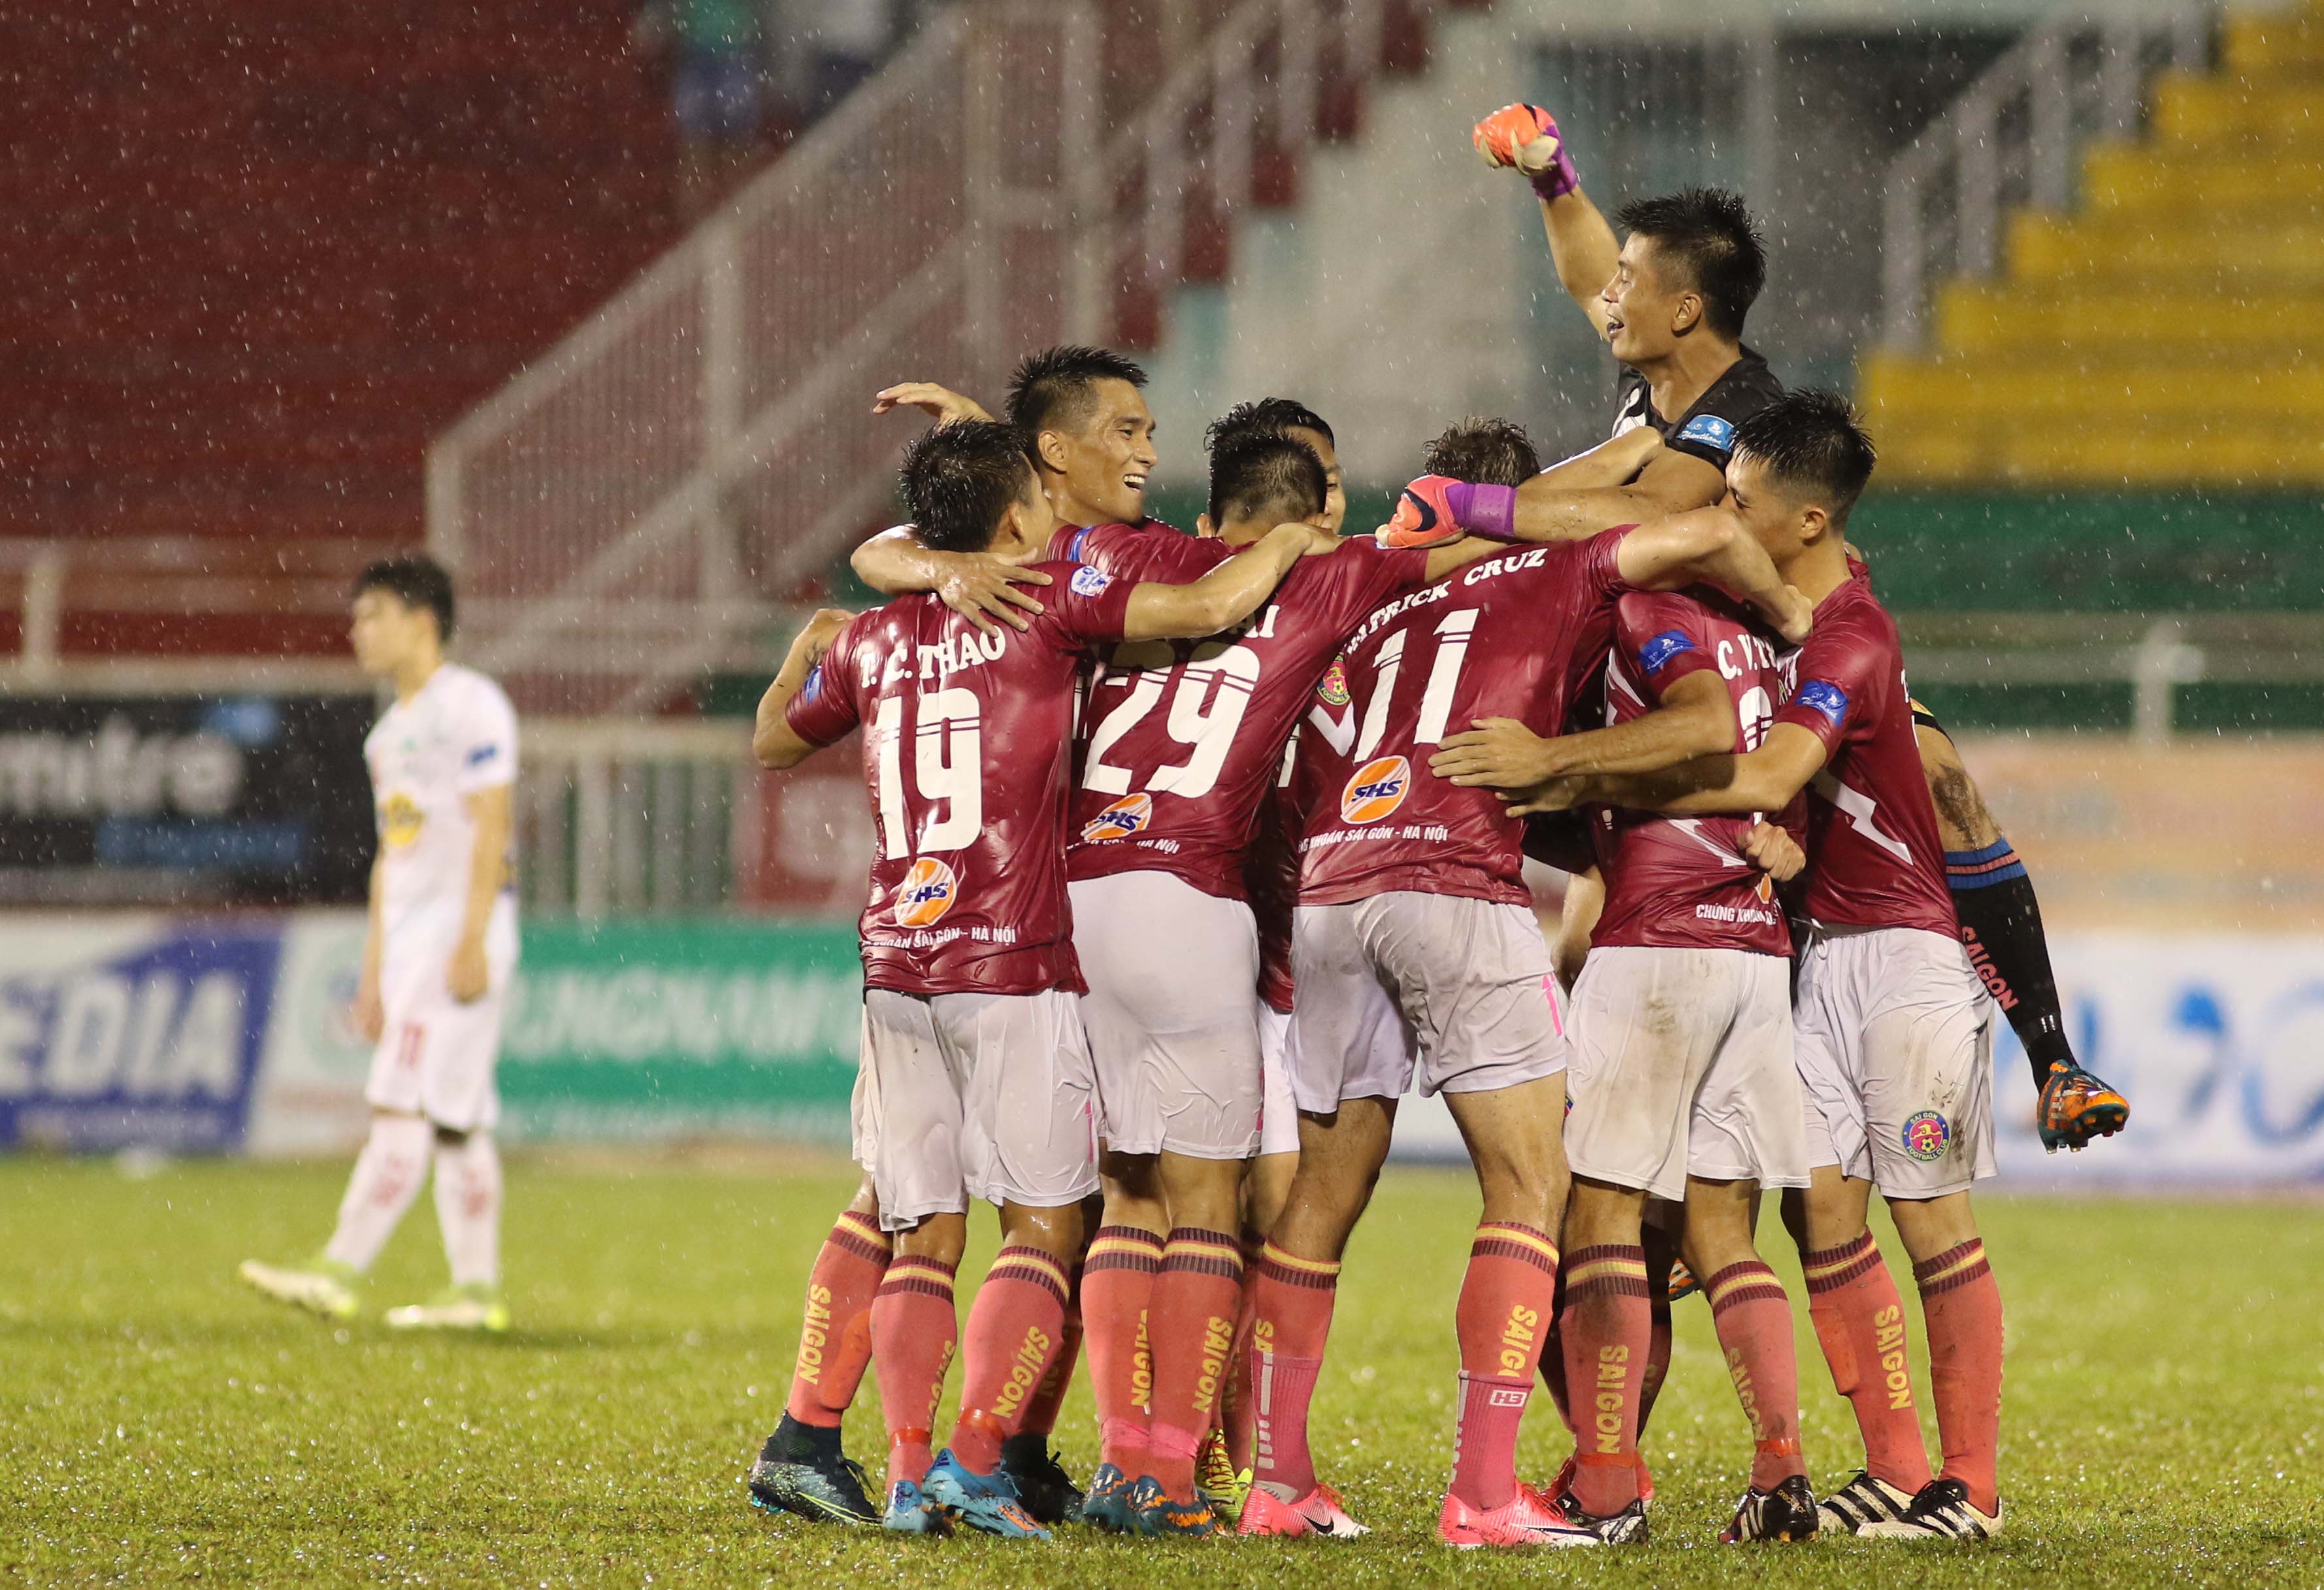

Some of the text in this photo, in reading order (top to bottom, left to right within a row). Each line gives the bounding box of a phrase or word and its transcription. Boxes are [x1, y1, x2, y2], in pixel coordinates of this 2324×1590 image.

[1464, 548, 1548, 586] CRUZ
[1081, 640, 1260, 799] 29
[1353, 608, 1480, 763] 11
[874, 687, 982, 861] 19
[1351, 780, 1403, 802] SHS
[902, 882, 949, 904] SHS
[993, 925, 1017, 946] NỘI
[1906, 1145, 1939, 1160] FOOTBALL
[798, 1284, 831, 1385] SAIGON
[990, 1326, 1050, 1419] SAIGON
[1192, 1316, 1234, 1414] SAIGON
[1874, 1304, 1912, 1410] SAIGON
[1596, 1345, 1629, 1454] SAIGON
